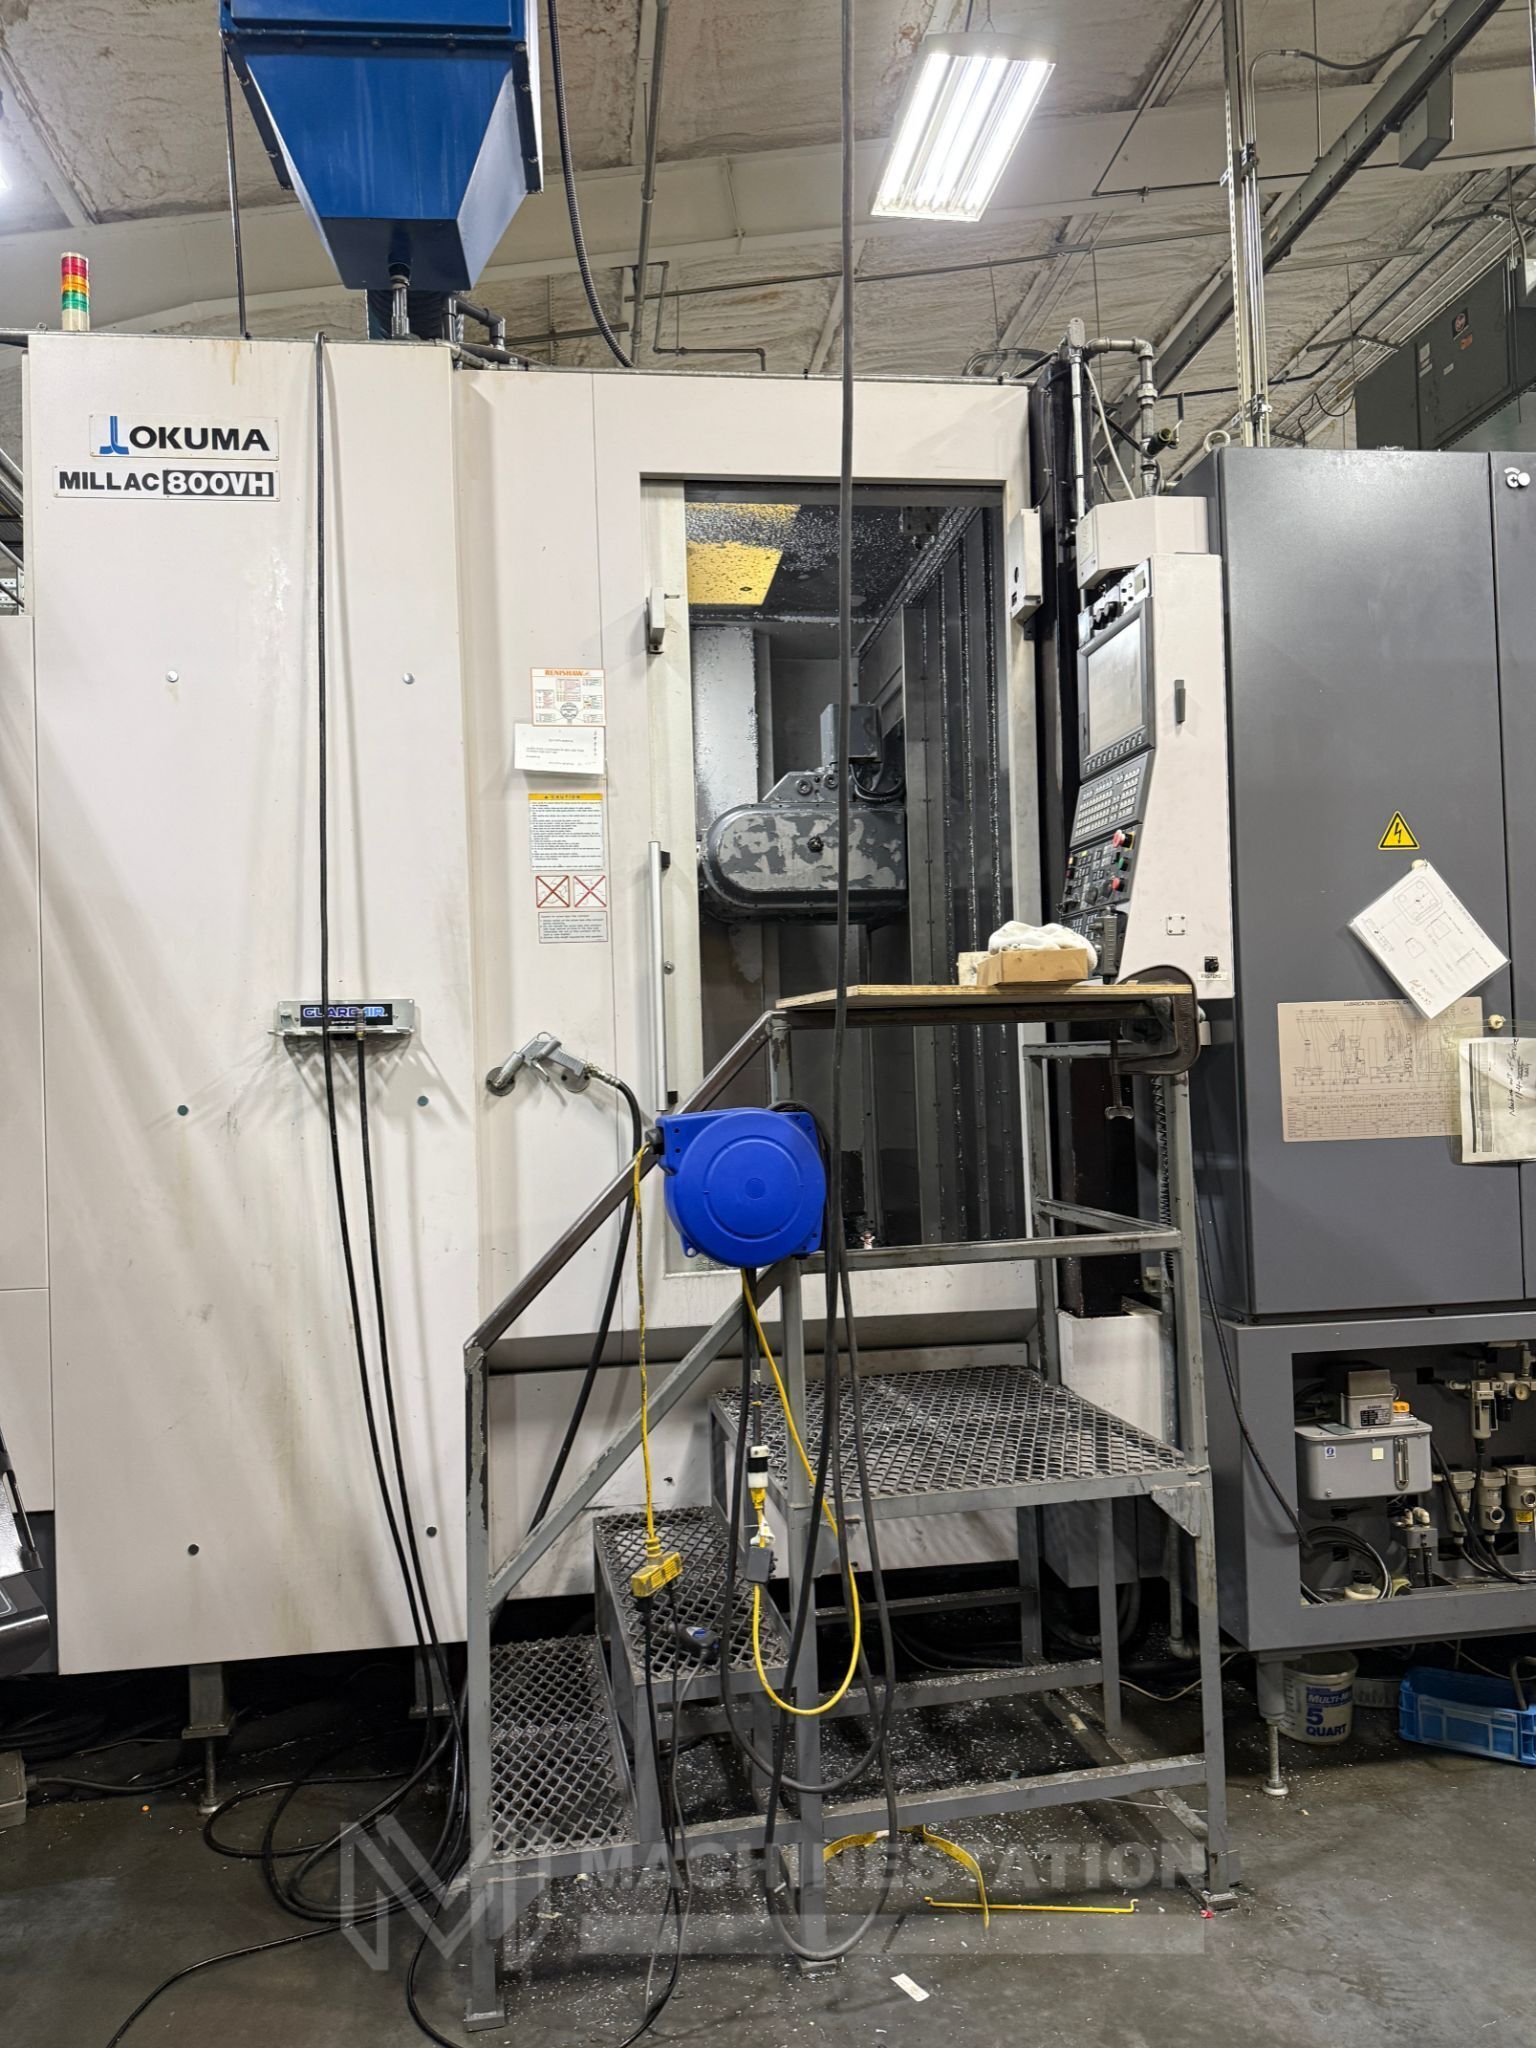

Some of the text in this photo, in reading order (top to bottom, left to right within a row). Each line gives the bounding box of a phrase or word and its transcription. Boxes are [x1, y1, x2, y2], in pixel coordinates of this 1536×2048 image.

[129, 426, 271, 451] OKUMA
[59, 471, 271, 495] MILLAC 800VH
[1306, 1707, 1324, 1725] 5
[1306, 1723, 1347, 1737] QUART
